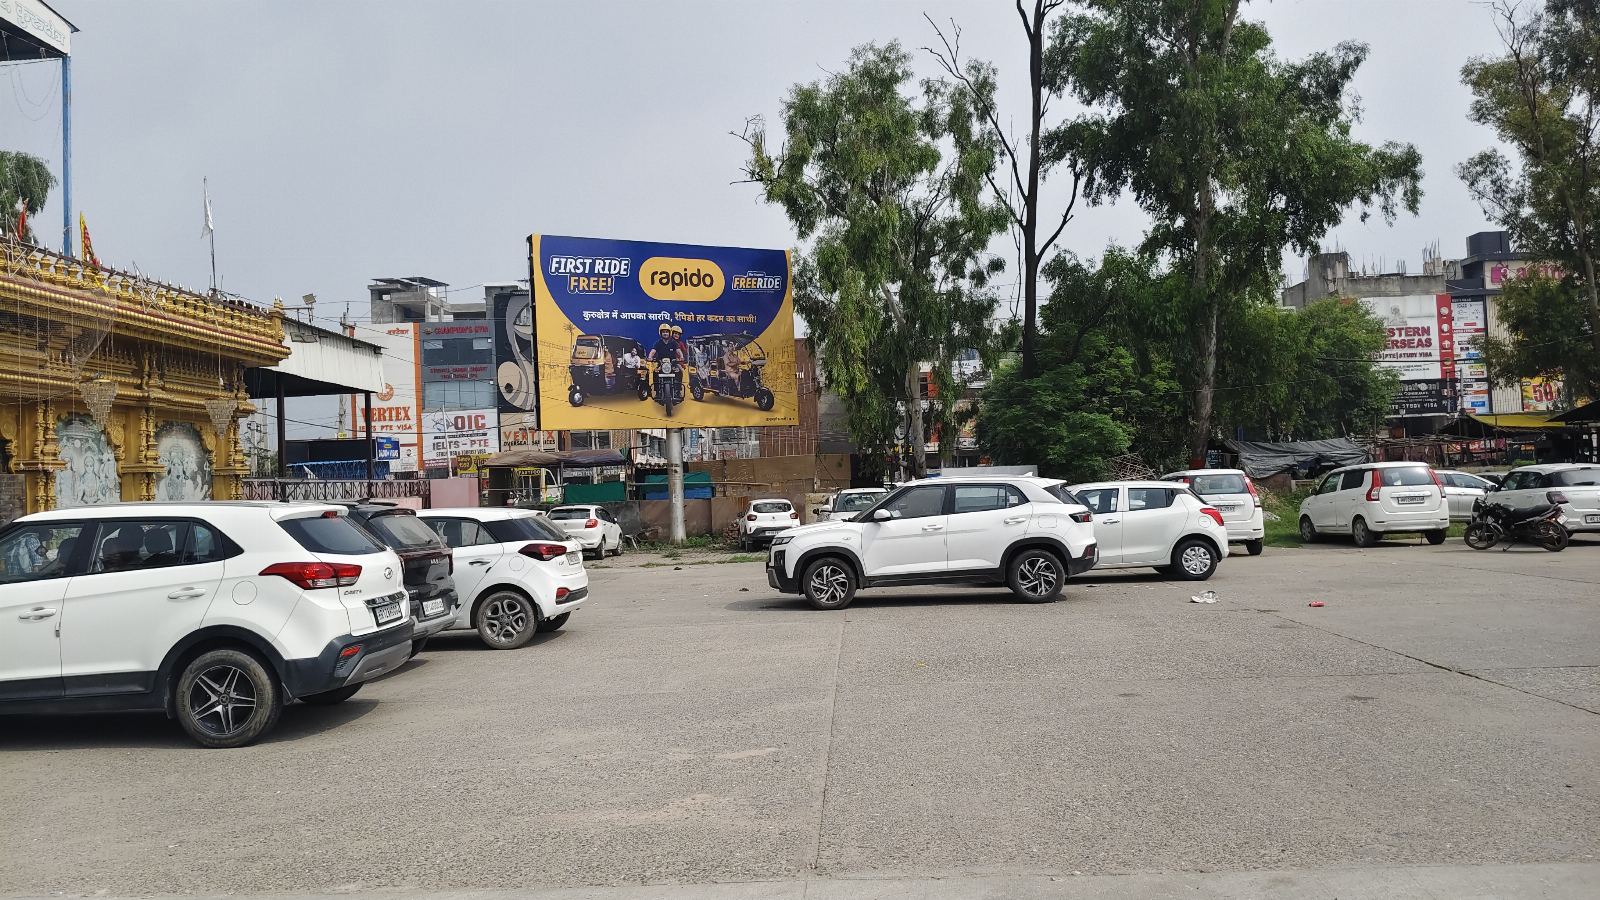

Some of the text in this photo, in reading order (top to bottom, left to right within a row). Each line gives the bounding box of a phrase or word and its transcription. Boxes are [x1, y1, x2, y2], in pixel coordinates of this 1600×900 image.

[551, 257, 629, 275] FIRST RIDE
[570, 276, 612, 292] FREE!
[650, 268, 714, 291] rapido
[582, 309, 610, 321] कुरुक्षेत्र
[611, 309, 619, 319] में
[620, 312, 646, 320] आपका
[696, 314, 706, 323] हर
[707, 314, 724, 322] कदम
[1386, 337, 1433, 349] ERSEAS
[453, 415, 486, 430] OIC
[432, 440, 460, 451] IELTS
[470, 439, 489, 447] PTE
